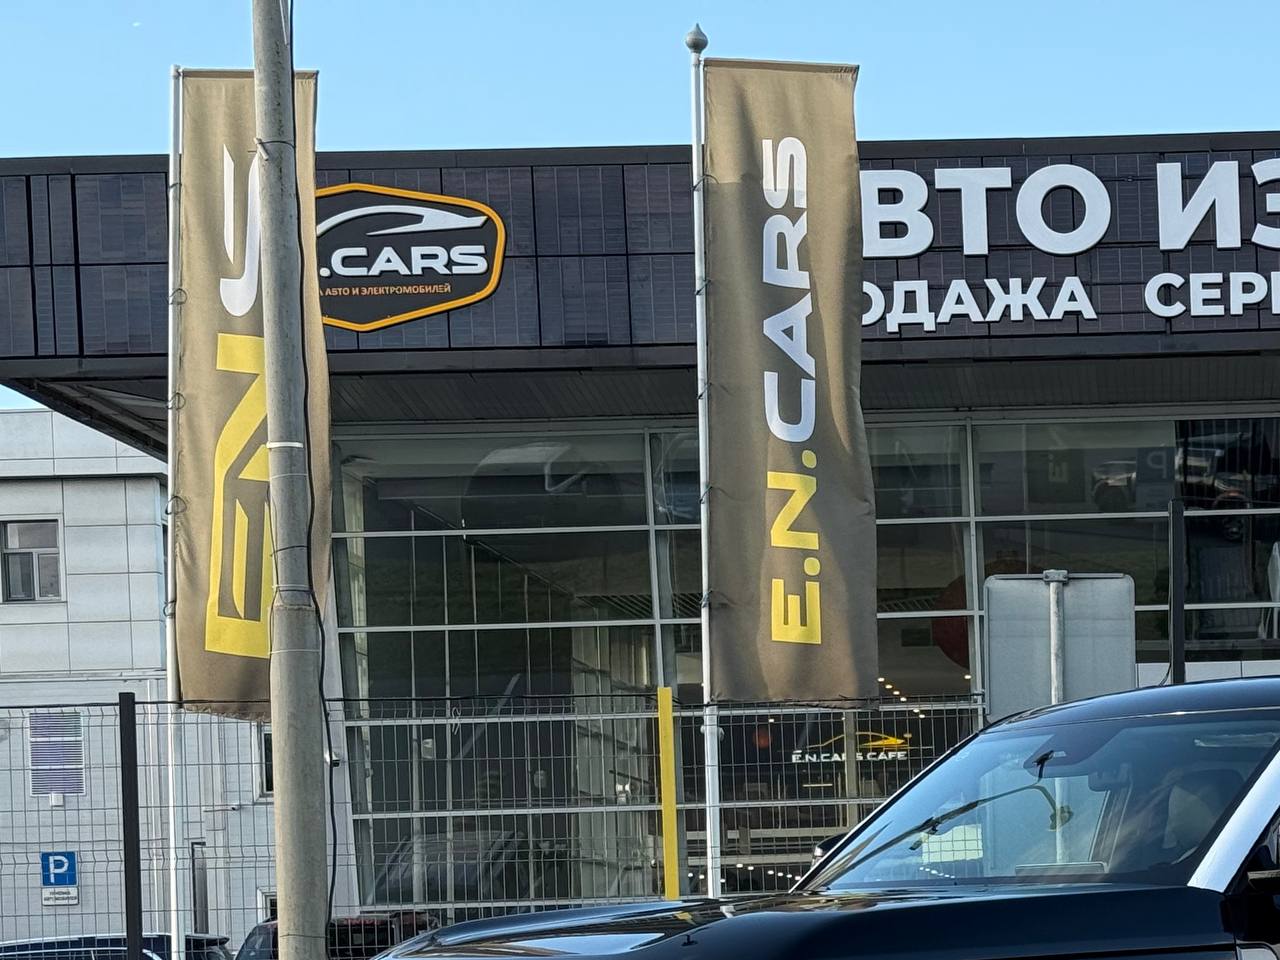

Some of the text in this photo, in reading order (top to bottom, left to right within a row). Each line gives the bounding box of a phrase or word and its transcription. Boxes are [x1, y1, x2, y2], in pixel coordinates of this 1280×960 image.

[859, 163, 1112, 257] ВТО
[319, 245, 488, 277] .CARS
[325, 286, 350, 296] АВТО
[352, 286, 360, 296] И
[361, 283, 452, 296] ЭЛЕКТРОМОБИЛЕЙ
[861, 275, 1097, 333] ДАЖА
[762, 136, 822, 645] E.N.CARS
[48, 855, 69, 884] P
